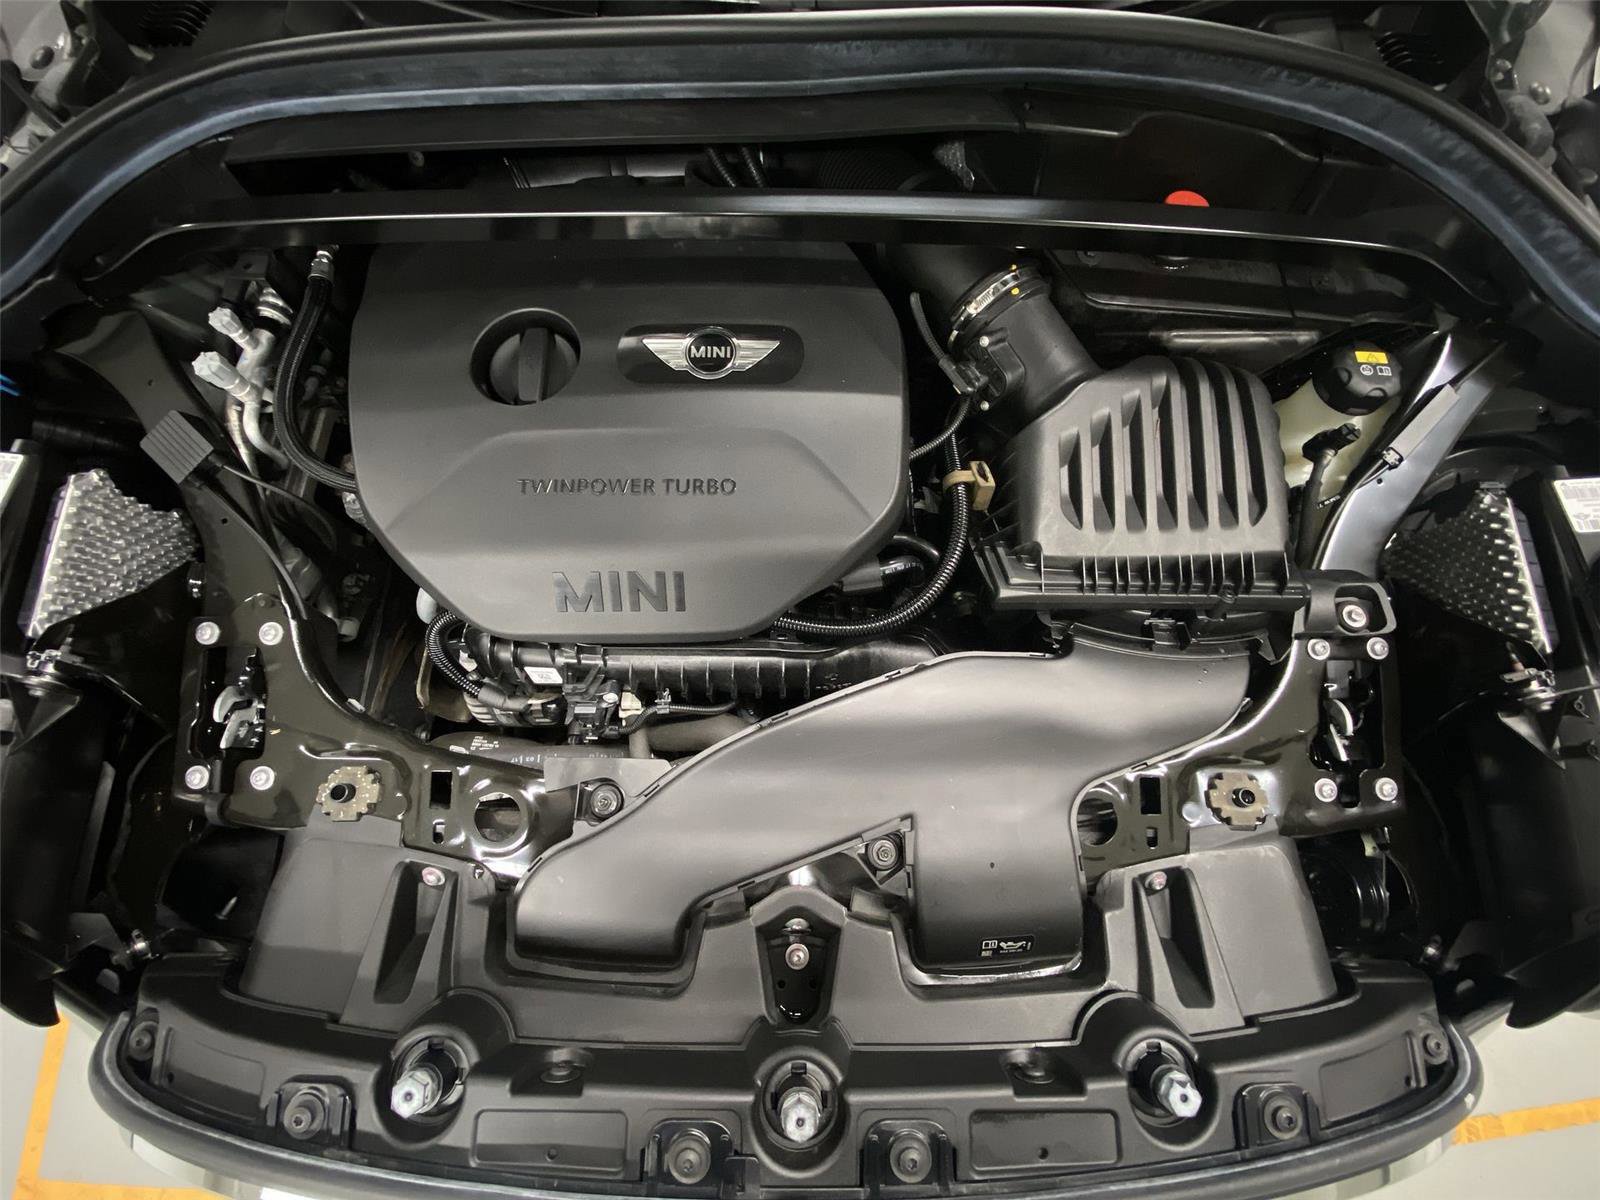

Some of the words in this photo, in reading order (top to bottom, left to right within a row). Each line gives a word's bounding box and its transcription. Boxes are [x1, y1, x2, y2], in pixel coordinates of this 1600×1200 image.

[690, 345, 731, 358] MINI
[517, 478, 656, 496] TWINPOWER
[663, 478, 737, 496] TURBO
[552, 570, 686, 612] MINI
